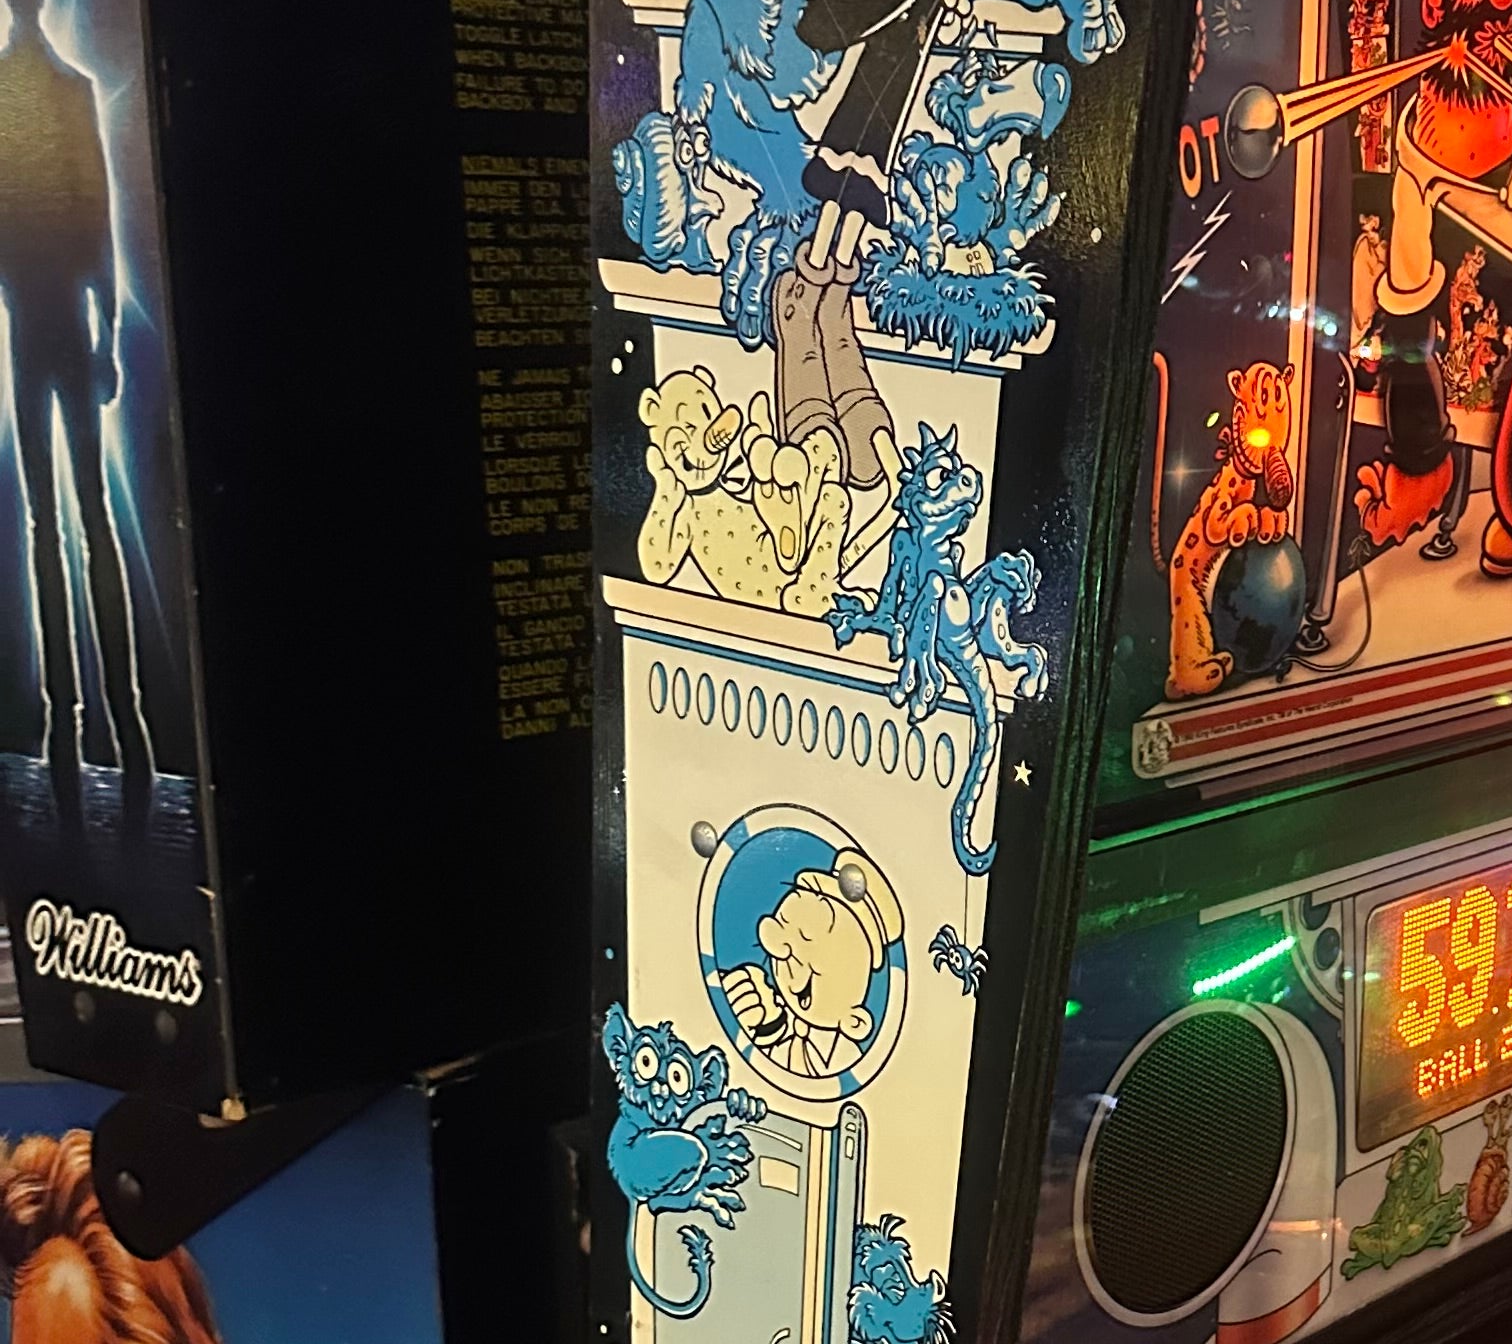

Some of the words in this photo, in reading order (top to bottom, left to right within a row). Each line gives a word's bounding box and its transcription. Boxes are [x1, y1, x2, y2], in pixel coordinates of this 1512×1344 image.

[453, 24, 523, 44] TOGGLE
[528, 31, 584, 48] LATCH
[26, 899, 203, 1006] Williams
[1418, 1038, 1489, 1097] BALL
